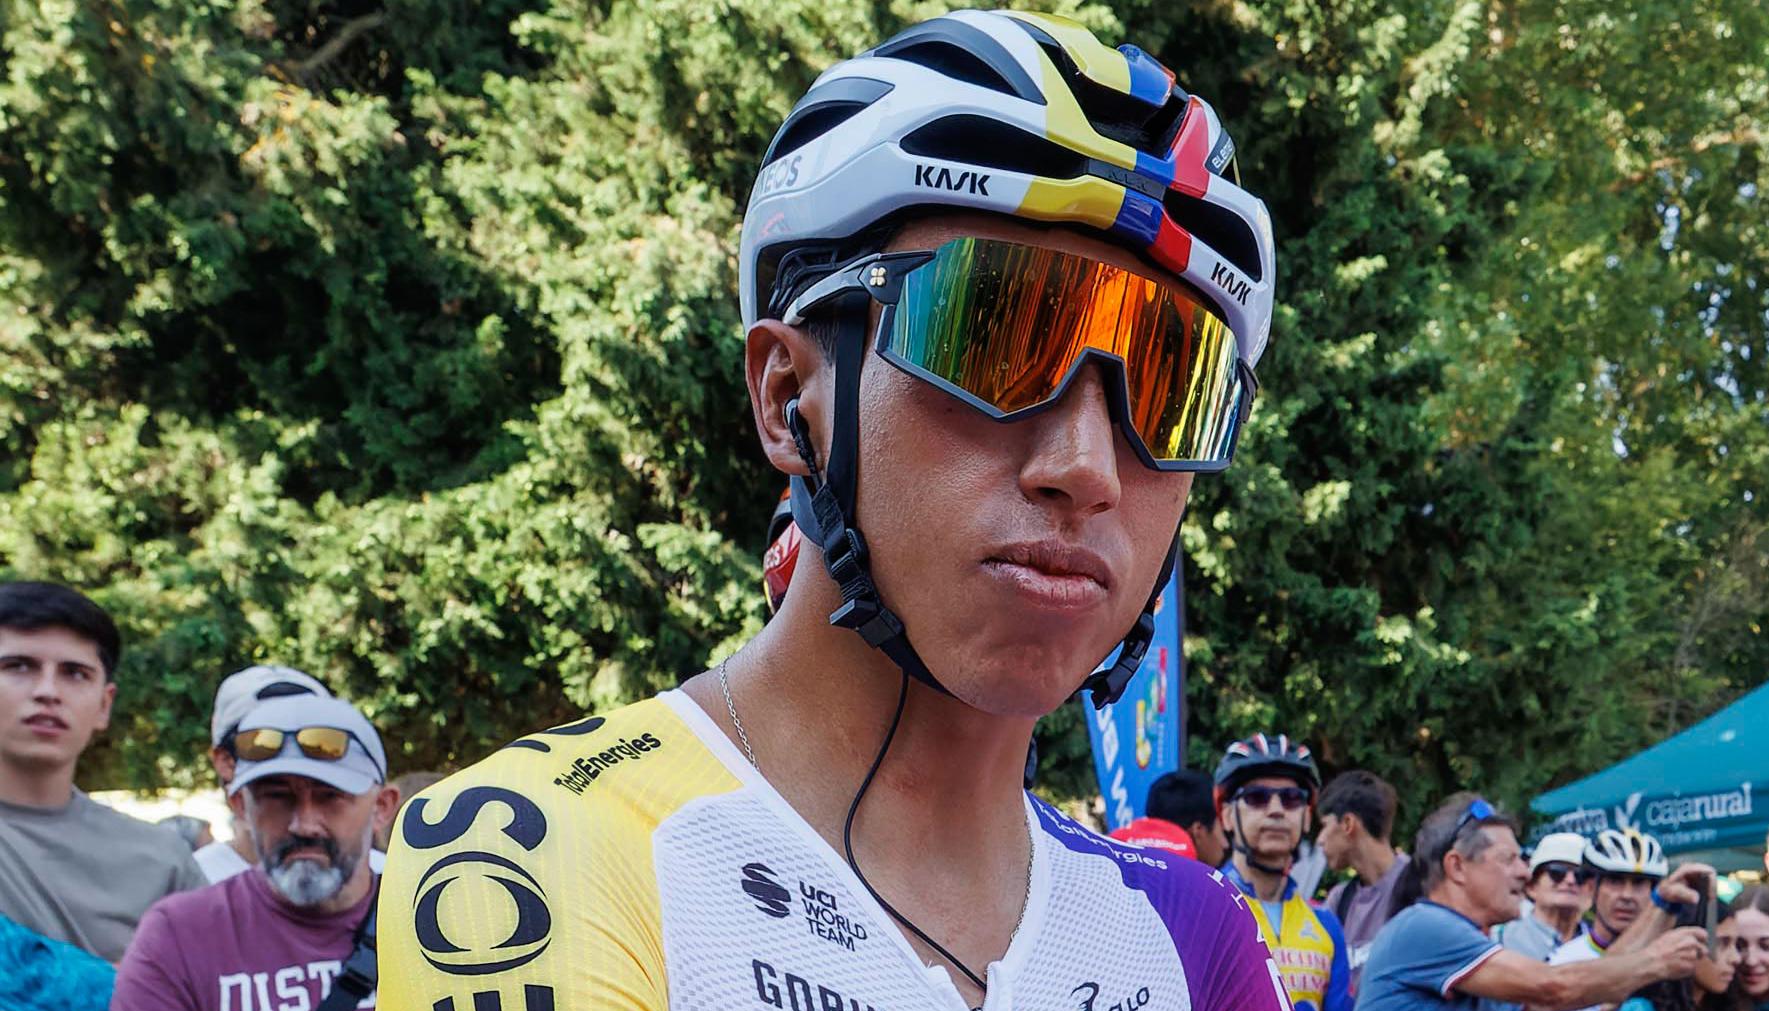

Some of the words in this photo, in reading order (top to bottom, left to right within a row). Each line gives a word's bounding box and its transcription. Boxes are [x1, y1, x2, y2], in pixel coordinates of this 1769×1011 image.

[914, 164, 991, 197] KASK
[1211, 262, 1252, 306] KASK
[554, 732, 663, 797] TotalEnergies
[799, 880, 838, 911] UCI
[801, 897, 868, 940] WORLD
[805, 916, 856, 952] TEAM
